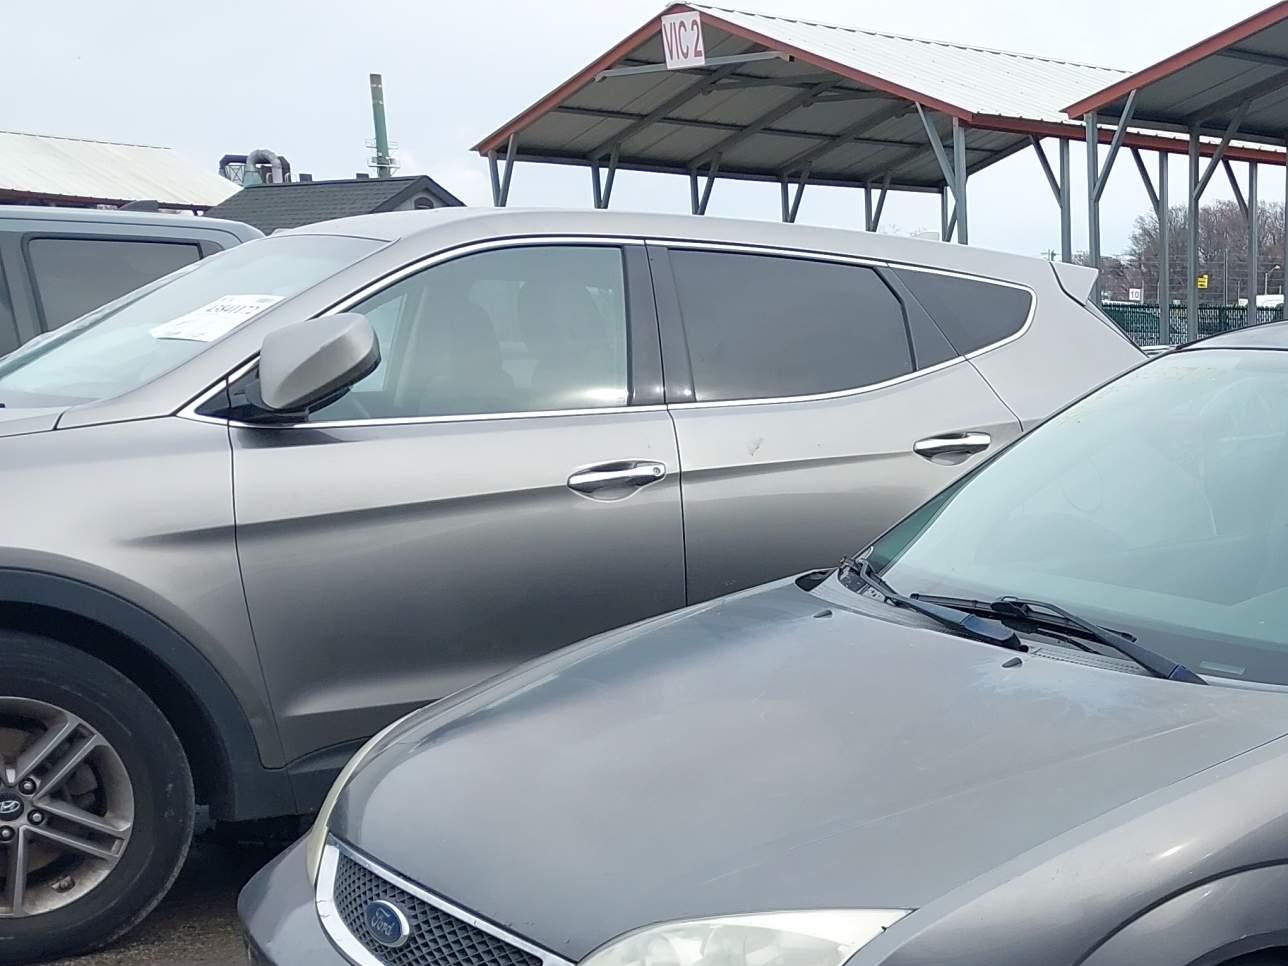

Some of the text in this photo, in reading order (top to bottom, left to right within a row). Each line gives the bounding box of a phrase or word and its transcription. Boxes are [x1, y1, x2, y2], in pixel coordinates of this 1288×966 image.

[663, 19, 703, 60] VIC 2
[371, 907, 396, 936] Ford
